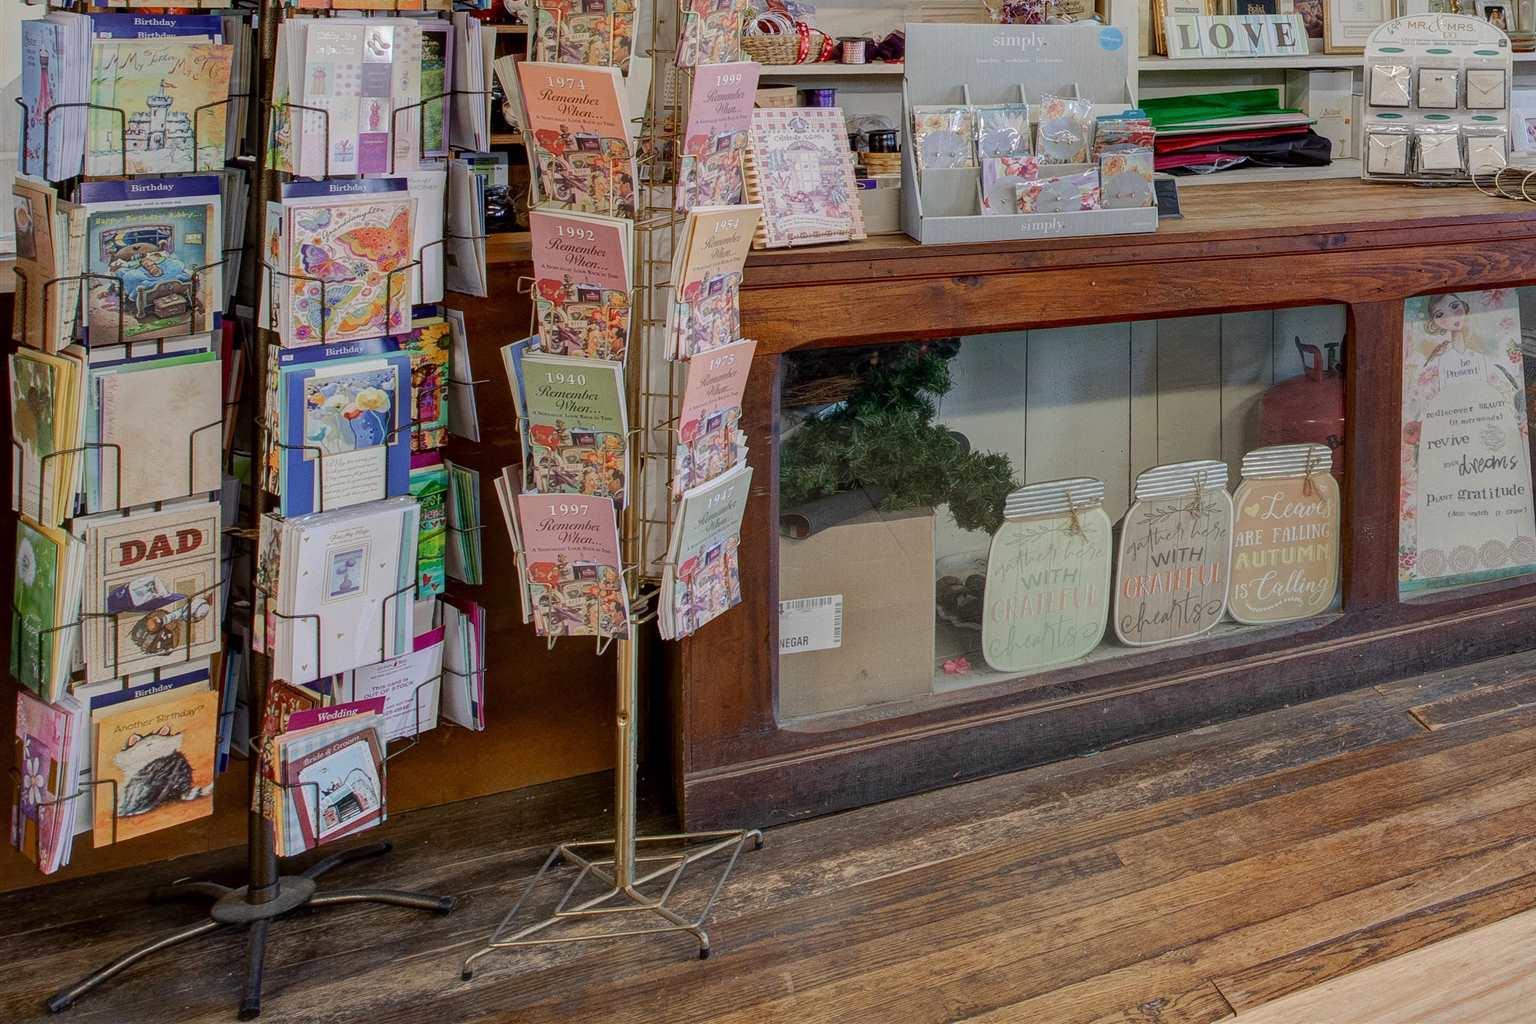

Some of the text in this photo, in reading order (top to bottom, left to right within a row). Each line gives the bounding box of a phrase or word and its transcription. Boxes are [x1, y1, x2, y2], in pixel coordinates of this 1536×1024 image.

[134, 17, 177, 28] Birthday
[1178, 21, 1297, 51] LOVE
[538, 88, 601, 106] Remember
[131, 182, 176, 193] Birthday
[329, 183, 368, 193] Birthday
[556, 225, 595, 241] 1992
[545, 238, 607, 257] Remember
[325, 347, 364, 357] Birthday
[545, 372, 586, 386] 1940
[536, 384, 600, 401] Remember
[1427, 434, 1470, 450] revive
[1458, 453, 1519, 476] dreams
[1457, 484, 1525, 501] gratitude
[548, 503, 591, 517] 1997
[536, 518, 600, 532] Remember
[1234, 523, 1330, 548] ARE FALLING
[119, 527, 204, 567] DAD
[1151, 547, 1204, 567] WITH
[1235, 544, 1330, 570] AUTUMN
[1020, 567, 1078, 591] WITH
[1234, 584, 1249, 600] IS
[1250, 569, 1330, 606] Calling
[134, 682, 174, 698] Birthday
[318, 708, 359, 722] Wedding
